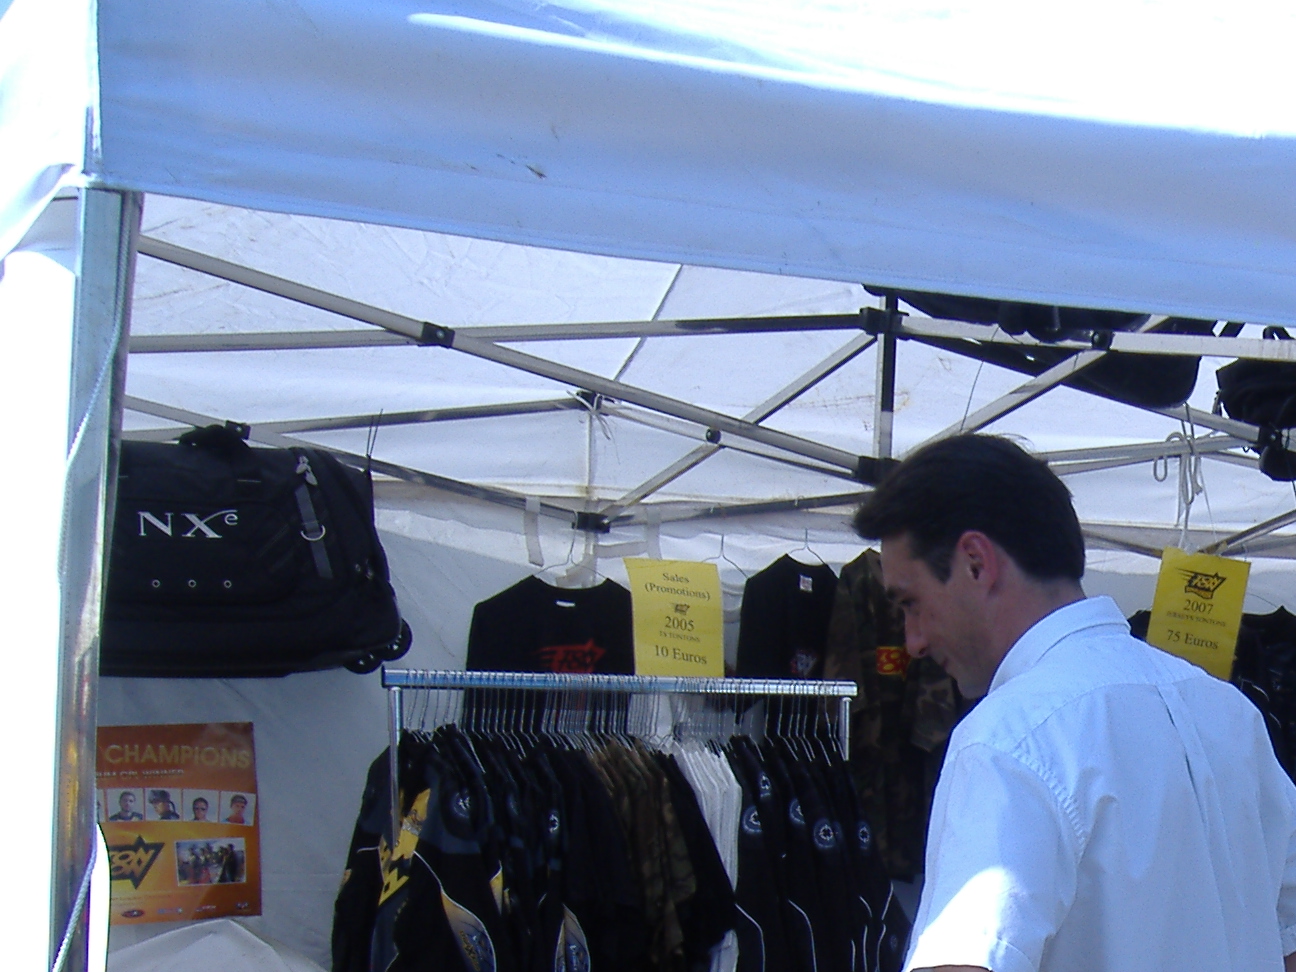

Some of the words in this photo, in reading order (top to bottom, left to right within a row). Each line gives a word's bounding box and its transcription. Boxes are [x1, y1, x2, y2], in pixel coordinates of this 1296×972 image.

[662, 572, 690, 584] Sales
[645, 582, 711, 601] (Promotions)
[1184, 599, 1214, 615] 2007
[665, 615, 695, 632] 2005
[1167, 629, 1181, 642] 75
[1185, 633, 1219, 650] Euros
[655, 645, 669, 657] 10
[673, 648, 708, 665] Euros
[104, 744, 252, 771] CHAMPIONS
